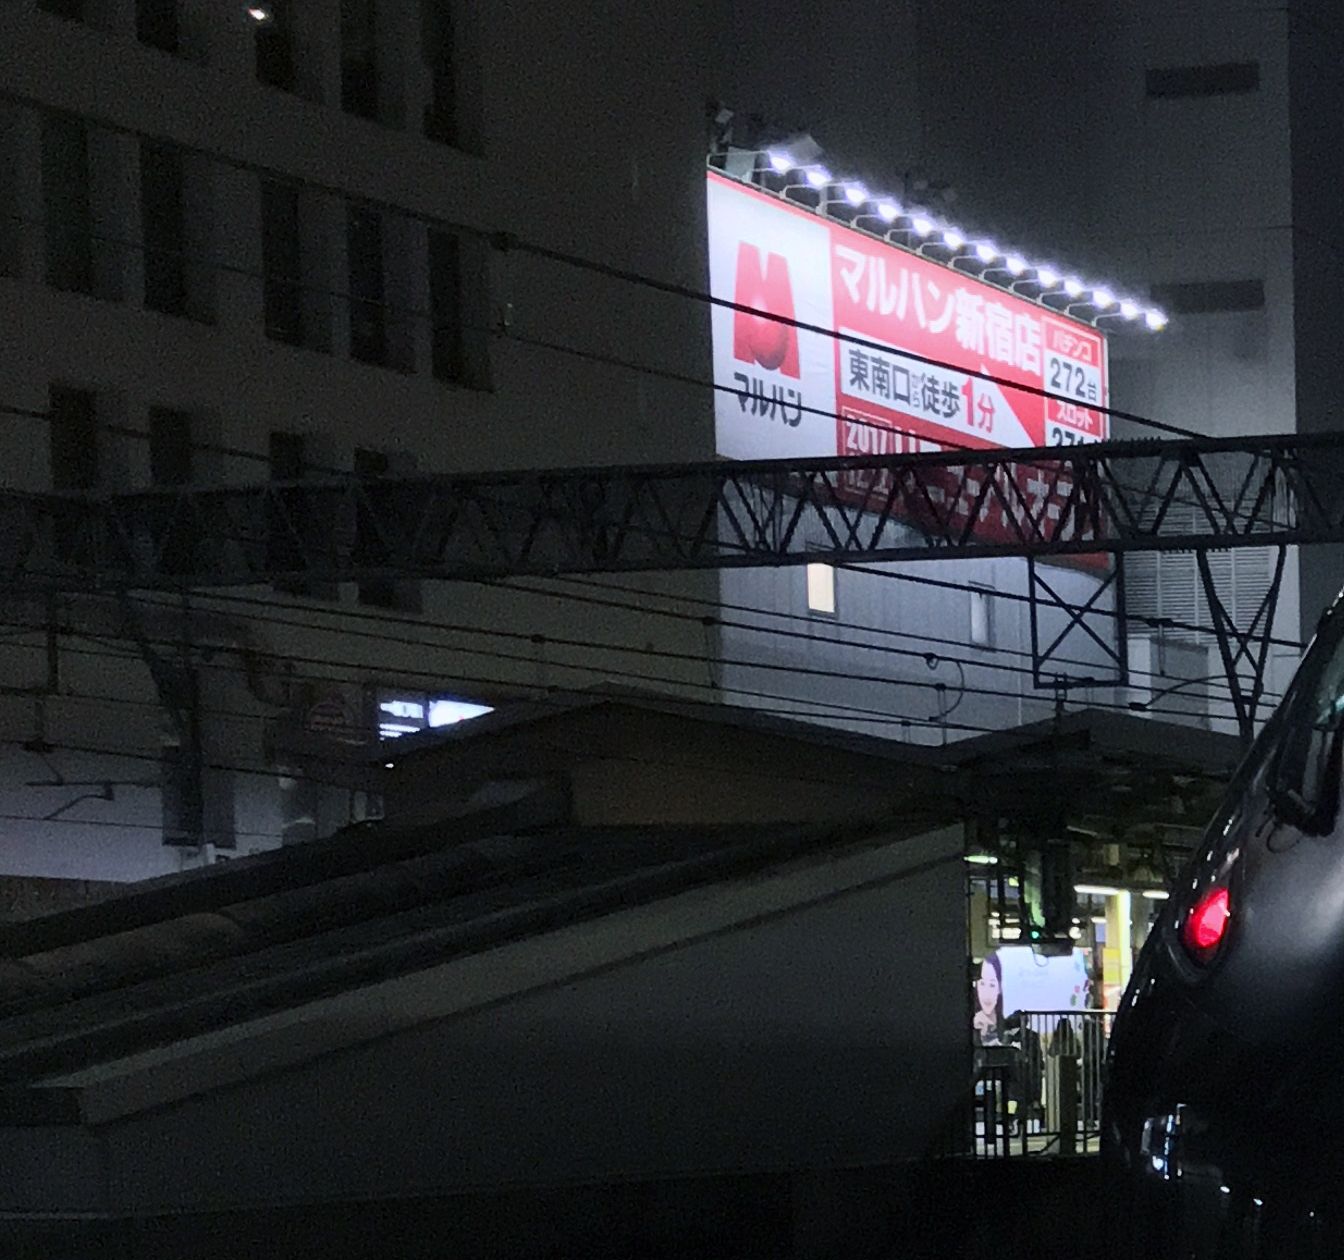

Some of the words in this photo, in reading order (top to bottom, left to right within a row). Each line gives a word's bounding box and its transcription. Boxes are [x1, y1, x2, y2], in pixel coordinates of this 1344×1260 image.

[835, 243, 1042, 377] マルハン新宿店
[1052, 329, 1092, 362] パチンコ
[733, 371, 802, 428] マルハン
[1050, 357, 1097, 402] 272台
